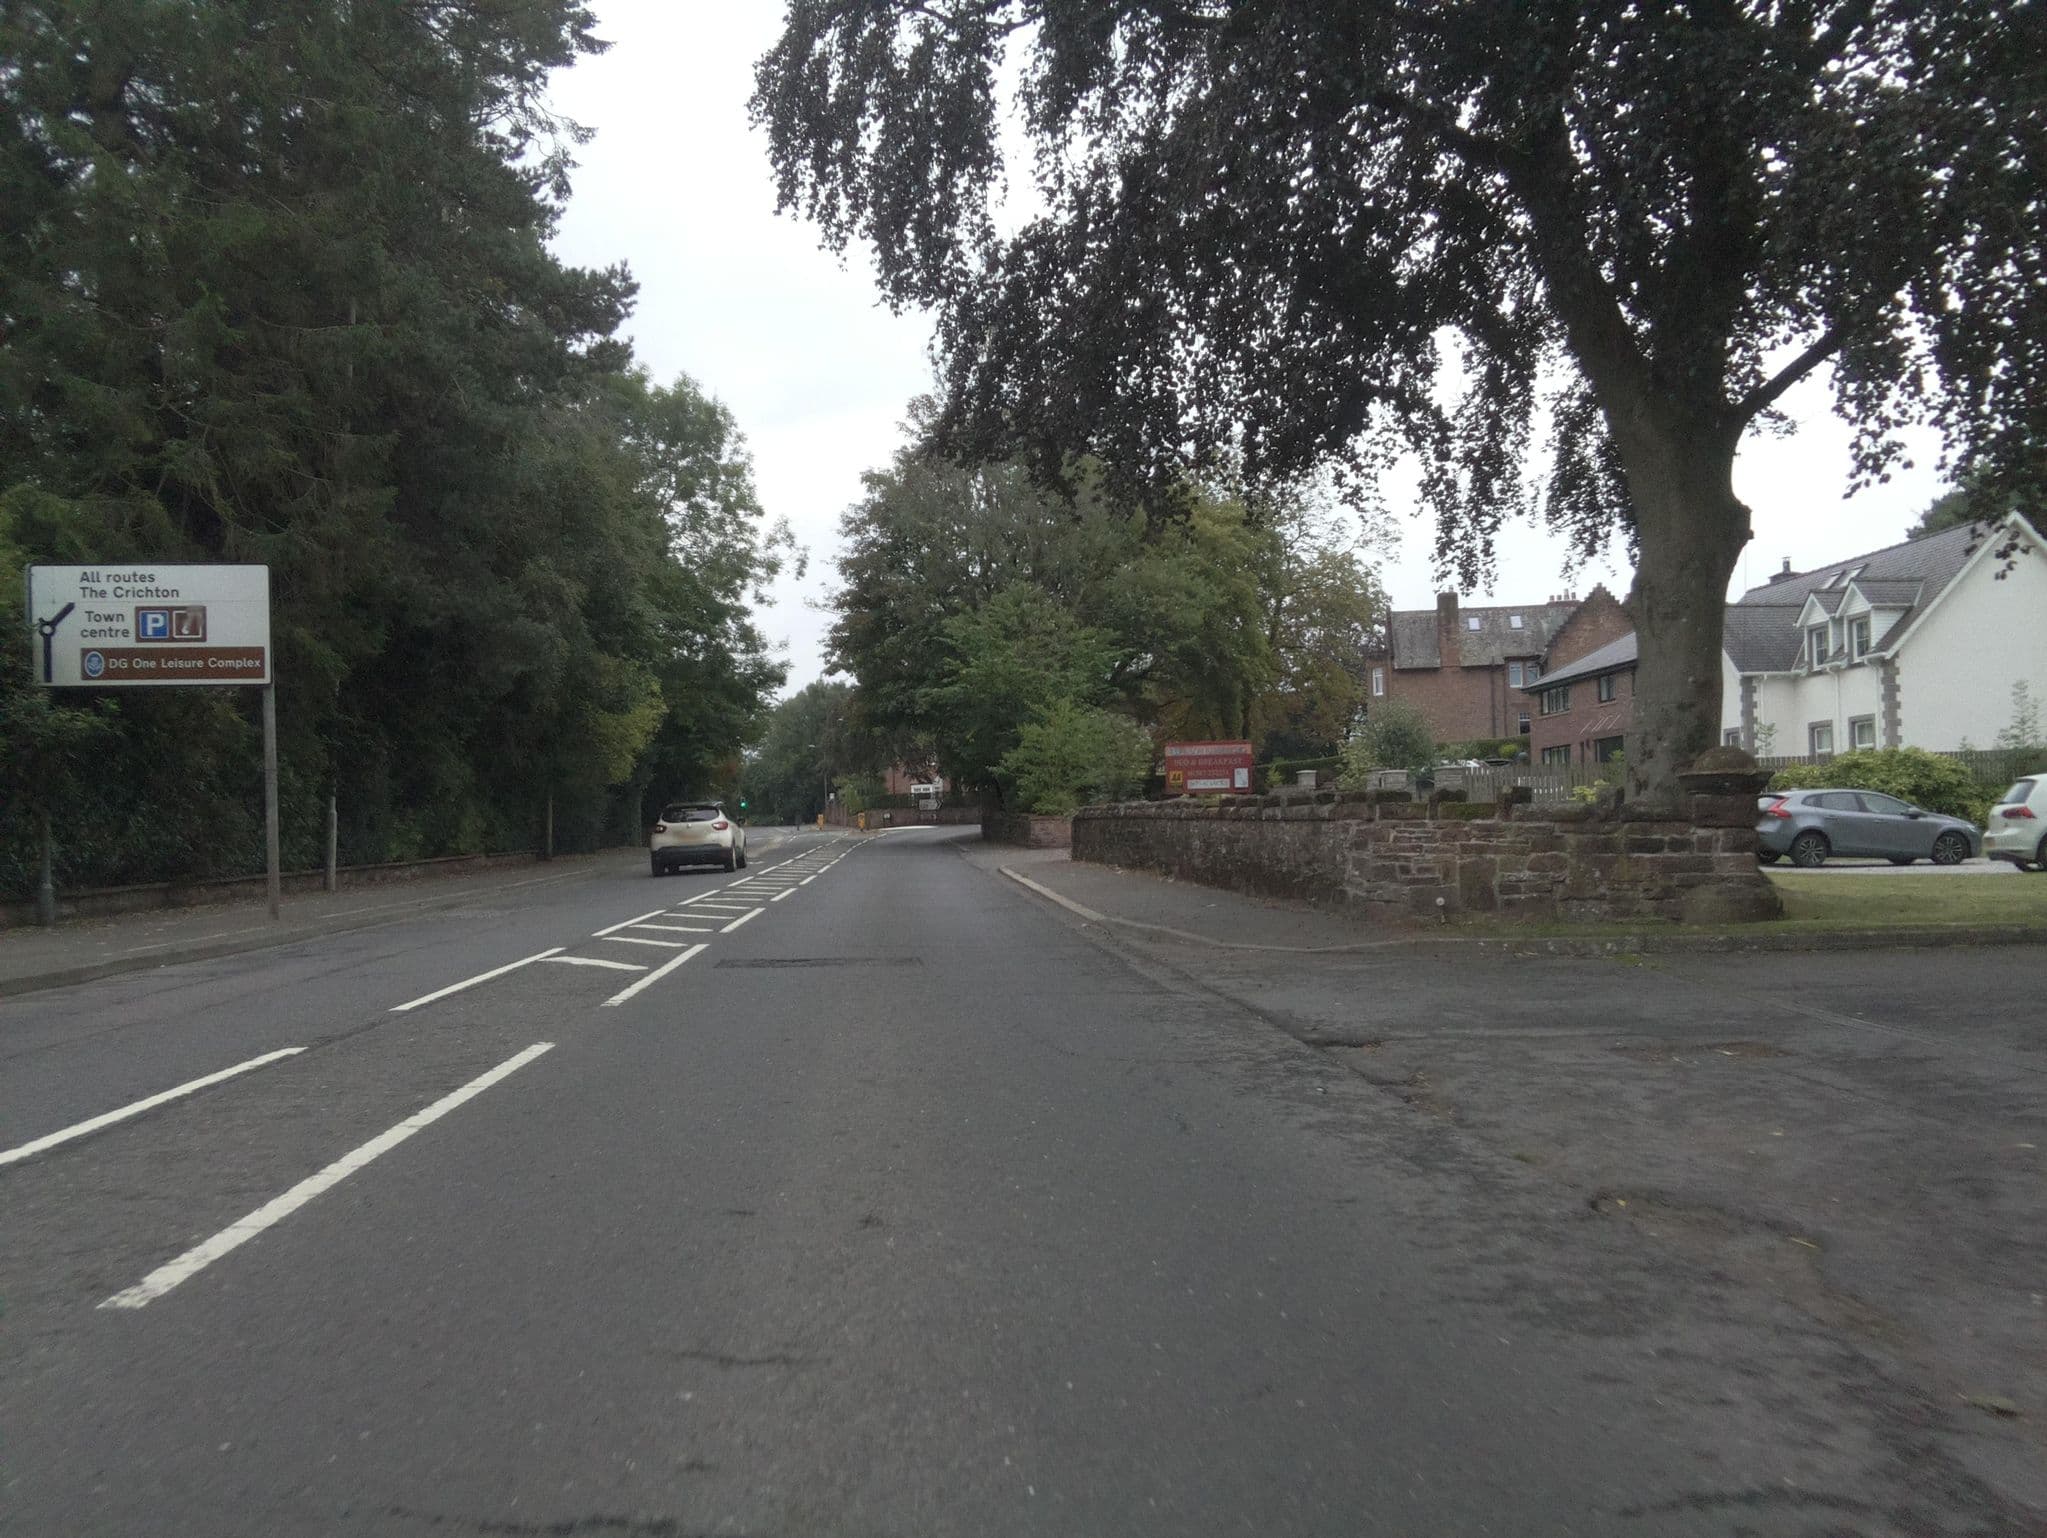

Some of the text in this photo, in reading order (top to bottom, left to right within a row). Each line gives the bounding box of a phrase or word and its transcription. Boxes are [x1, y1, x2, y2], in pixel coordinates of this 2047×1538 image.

[80, 571, 155, 583] All routes
[80, 586, 179, 598] The Crichton
[85, 611, 125, 622] Town
[146, 614, 165, 635] P
[80, 628, 130, 638] centre
[109, 656, 261, 670] DG One Leisure Complex
